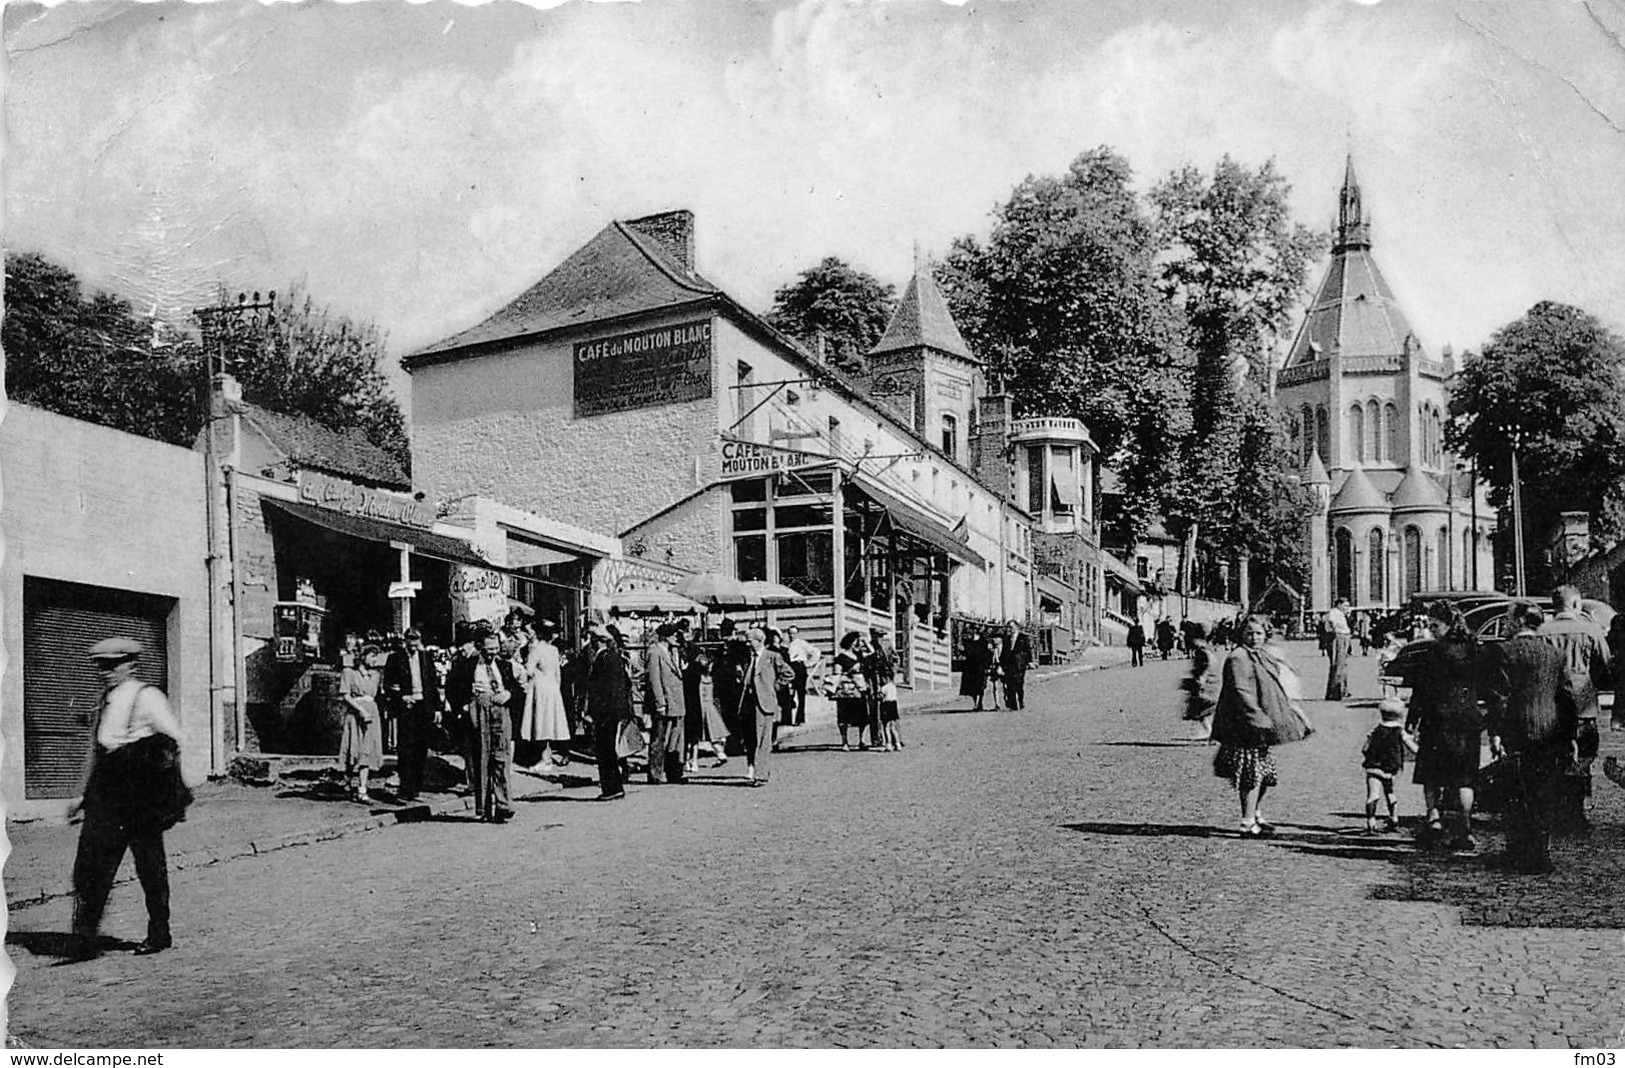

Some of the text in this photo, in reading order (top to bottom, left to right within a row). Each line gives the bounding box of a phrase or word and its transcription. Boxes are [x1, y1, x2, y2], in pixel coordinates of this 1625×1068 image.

[623, 330, 671, 354] MOUTON
[673, 323, 710, 346] BLANC
[721, 457, 770, 474] MOUTON
